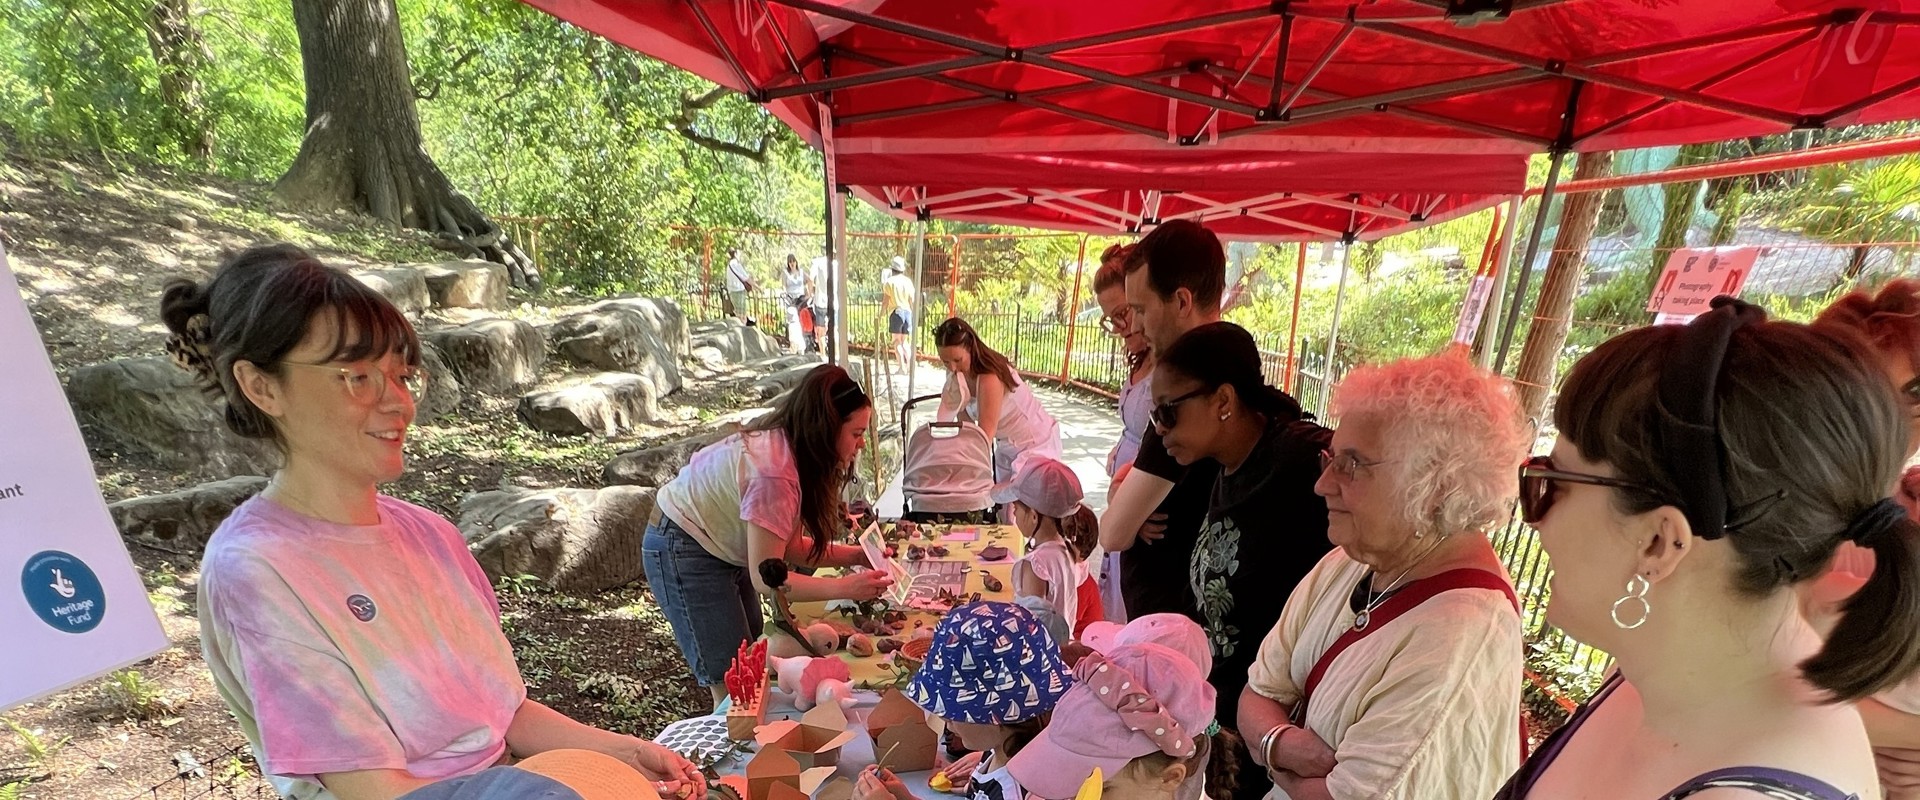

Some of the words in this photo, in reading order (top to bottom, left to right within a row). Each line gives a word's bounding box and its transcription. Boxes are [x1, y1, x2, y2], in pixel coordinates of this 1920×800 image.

[1678, 282, 1713, 292] Photography
[1672, 297, 1690, 306] taking
[1688, 297, 1706, 306] place
[51, 599, 94, 617] Heritage
[66, 611, 92, 626] Fund
